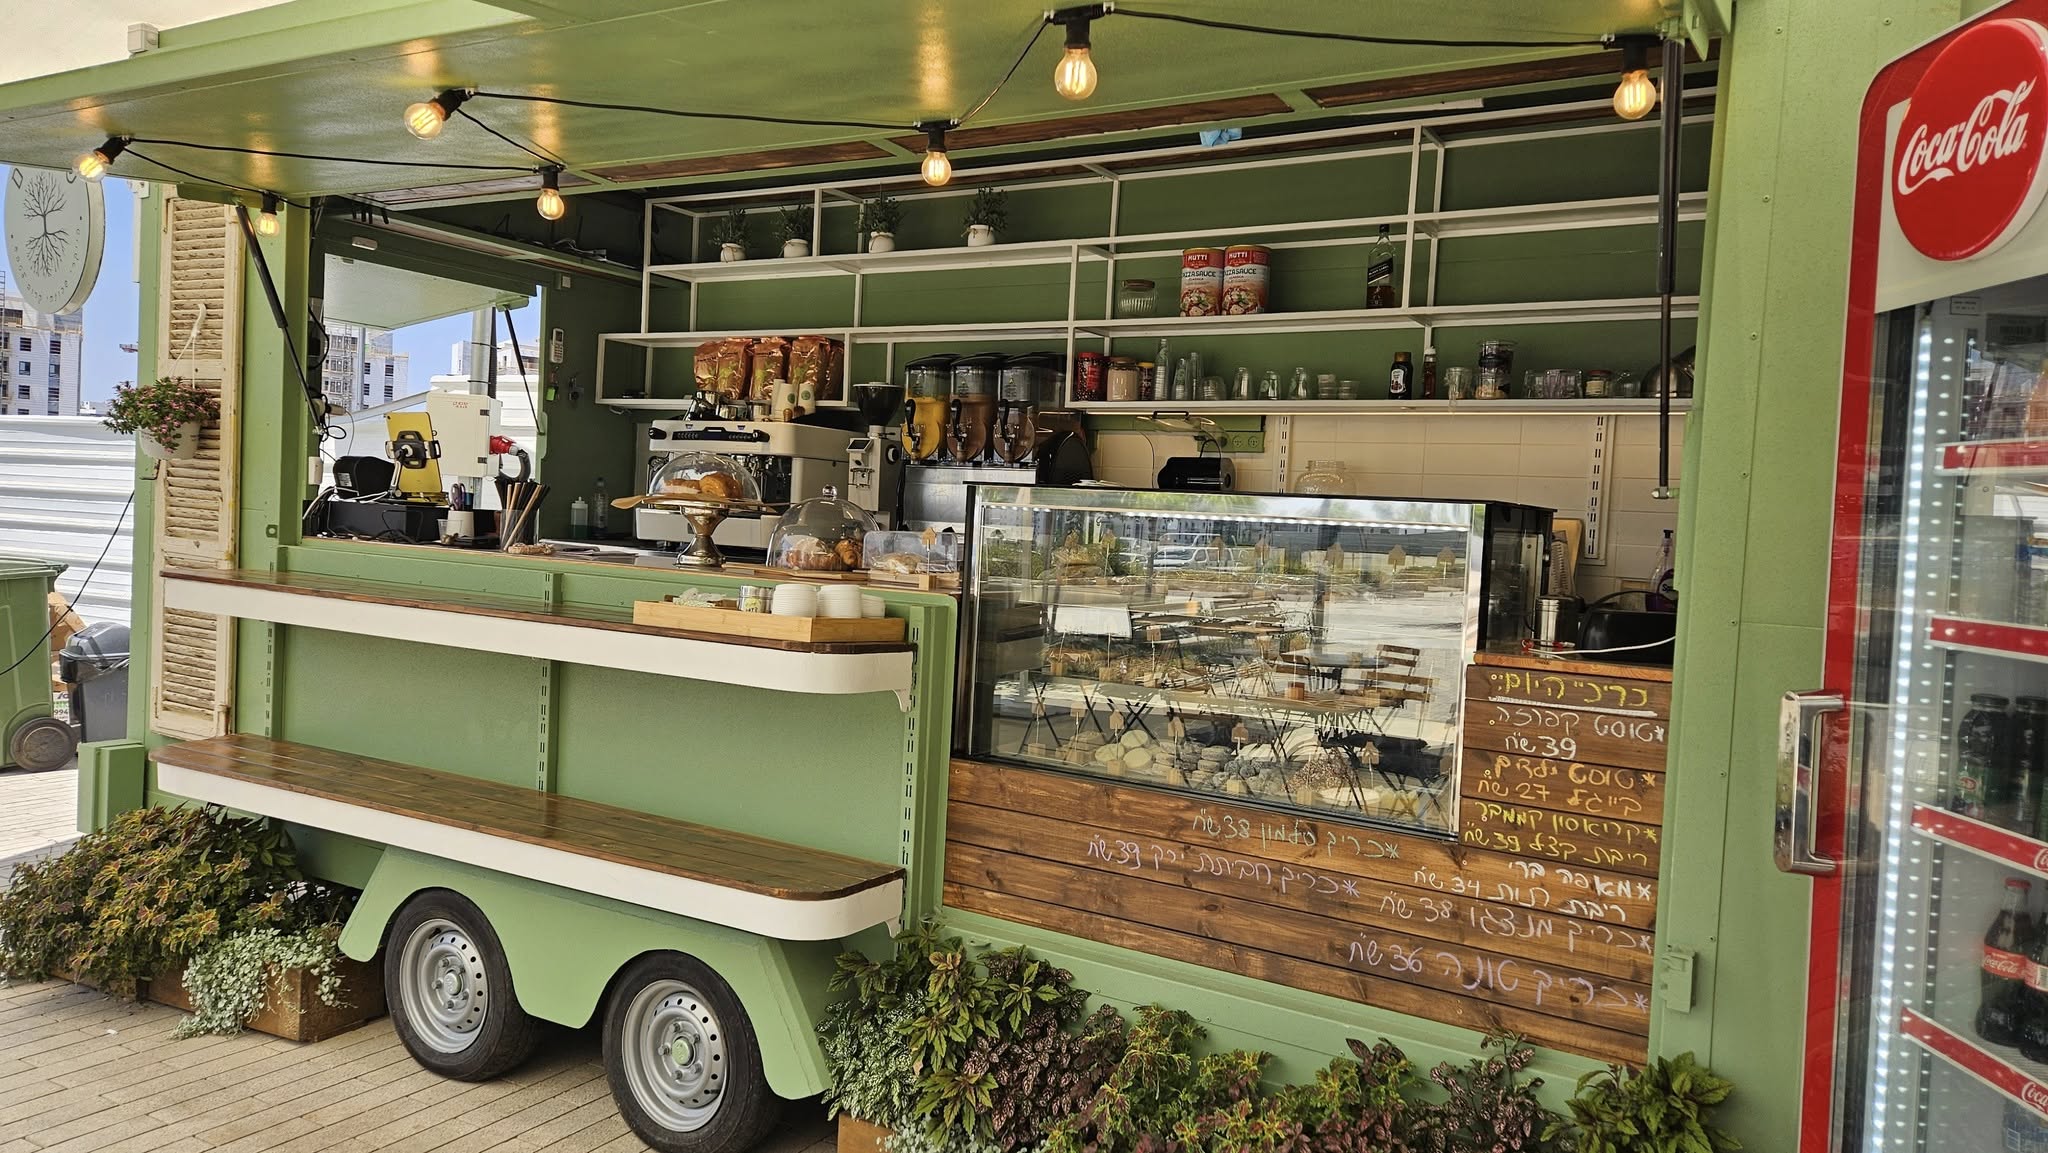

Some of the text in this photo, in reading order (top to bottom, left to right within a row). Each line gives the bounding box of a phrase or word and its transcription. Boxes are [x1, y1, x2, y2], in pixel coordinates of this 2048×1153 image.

[1897, 75, 2037, 196] Coca-Cola
[1187, 253, 1208, 261] MUTTI
[1228, 251, 1248, 259] MUTTI
[1496, 706, 1580, 736] קפרזה
[1537, 735, 1577, 760] 39
[1515, 783, 1550, 802] 27
[1566, 788, 1642, 816] בייגל
[1223, 815, 1250, 840] 38
[1115, 839, 1142, 870] 39
[1493, 832, 1521, 852] 39
[1583, 846, 1647, 867] ריבת
[1451, 876, 1480, 902] 34
[1487, 883, 1550, 907] תות
[1419, 898, 1453, 922] 38
[1559, 899, 1626, 922] ריבת
[1389, 944, 1424, 973] 36
[1436, 951, 1518, 991] טונה
